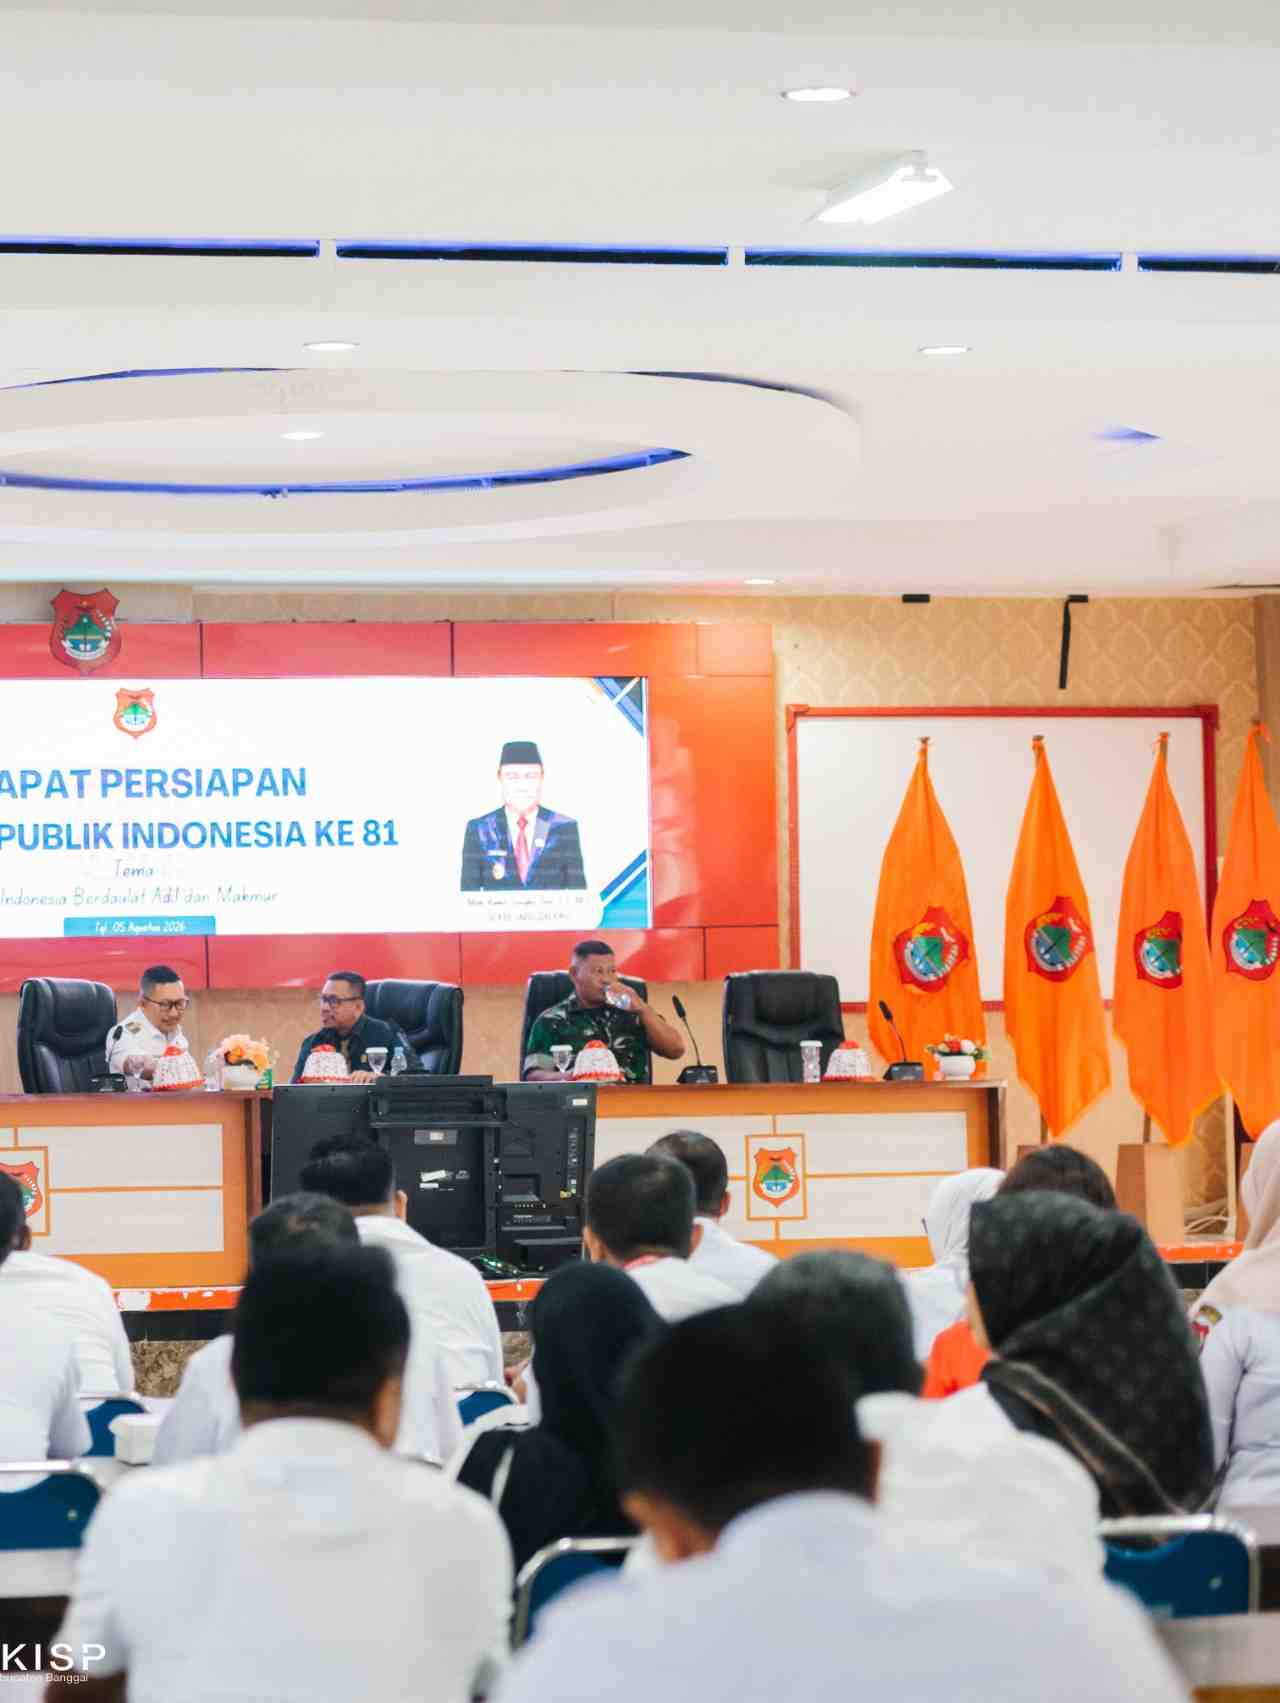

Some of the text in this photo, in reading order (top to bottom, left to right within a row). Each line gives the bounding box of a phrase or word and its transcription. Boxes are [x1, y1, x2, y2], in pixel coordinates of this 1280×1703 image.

[100, 767, 306, 798] PERSIAPAN
[122, 820, 306, 849] INDONESIA
[315, 820, 354, 847] KE
[362, 819, 399, 846] 81
[114, 859, 154, 877] Tema
[0, 887, 67, 905] Indonesia
[73, 886, 146, 906] Berdaulat
[185, 887, 210, 903] dan
[216, 883, 279, 904] Makmur
